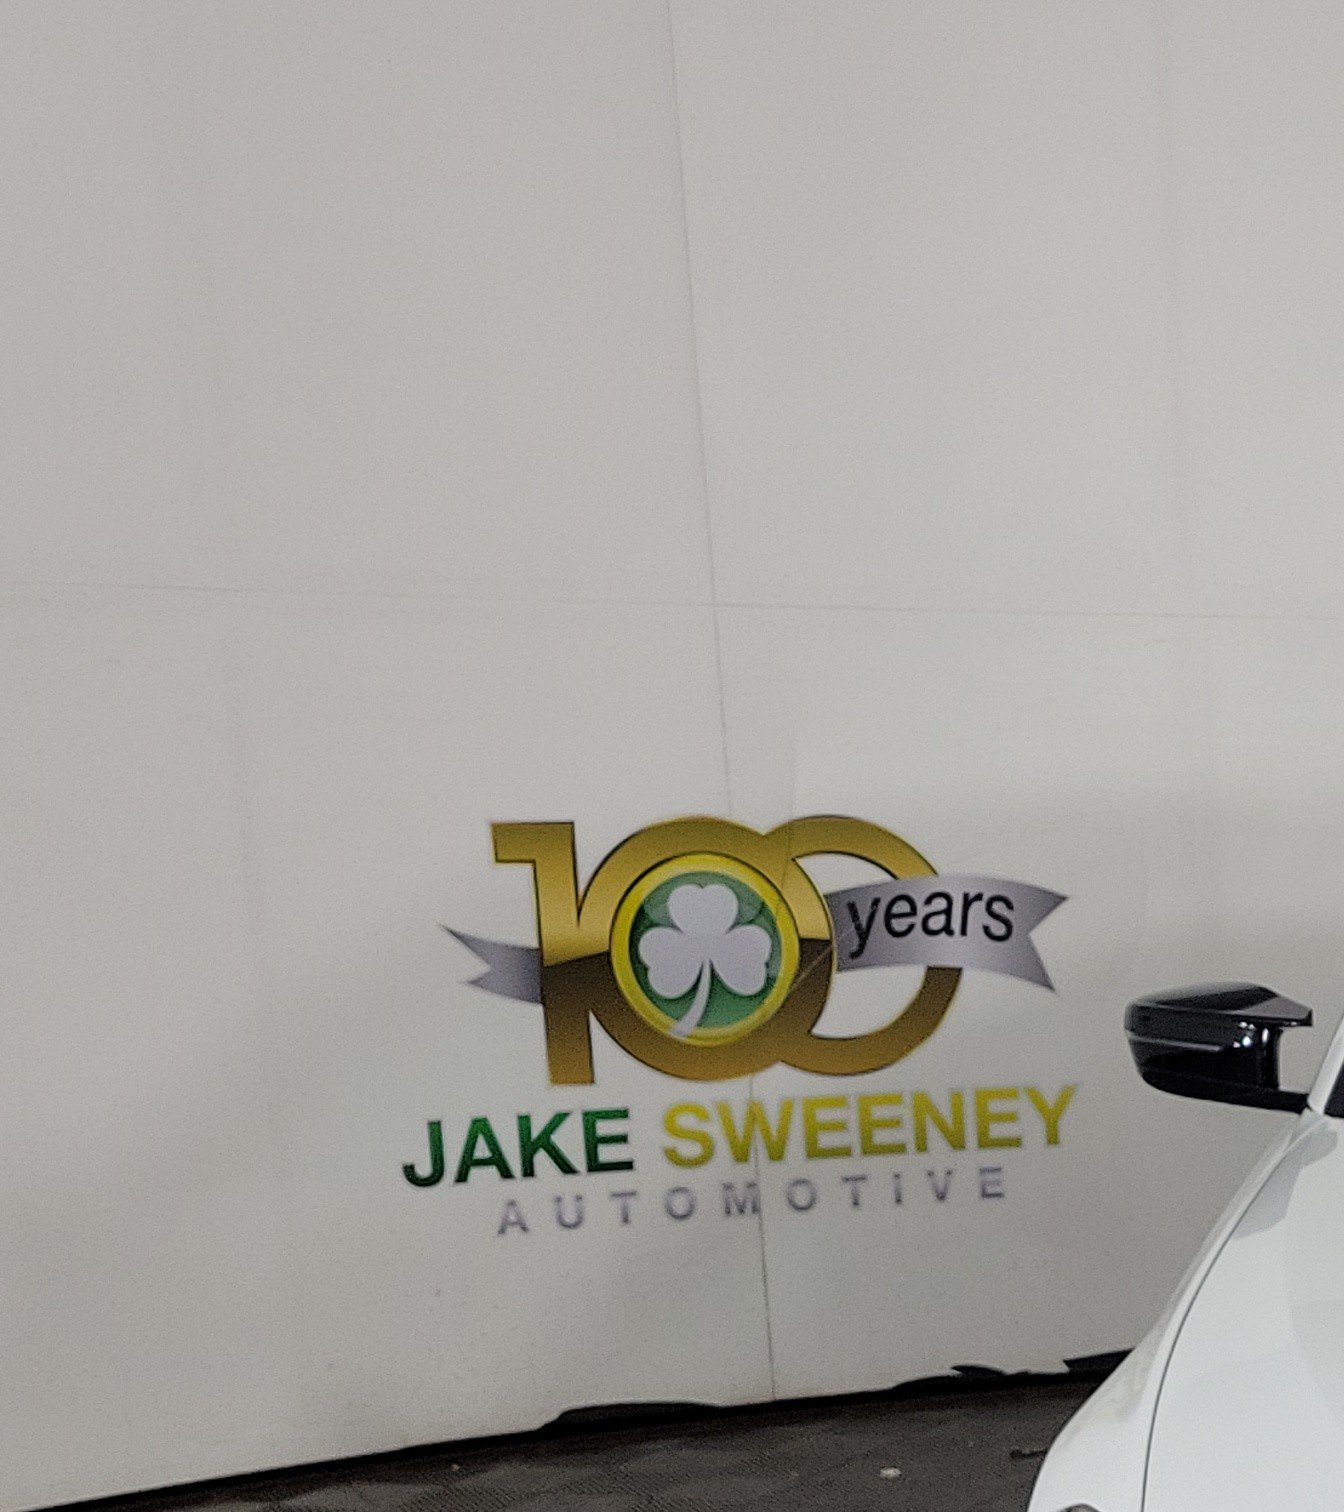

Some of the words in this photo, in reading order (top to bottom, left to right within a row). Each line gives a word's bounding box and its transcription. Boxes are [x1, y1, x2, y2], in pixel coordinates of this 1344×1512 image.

[490, 814, 964, 1086] 100
[844, 890, 1015, 960] years
[402, 1107, 634, 1188] JAKE
[662, 1084, 1077, 1169] SWEENEY
[497, 1165, 1005, 1235] AUTOMOTIVE
